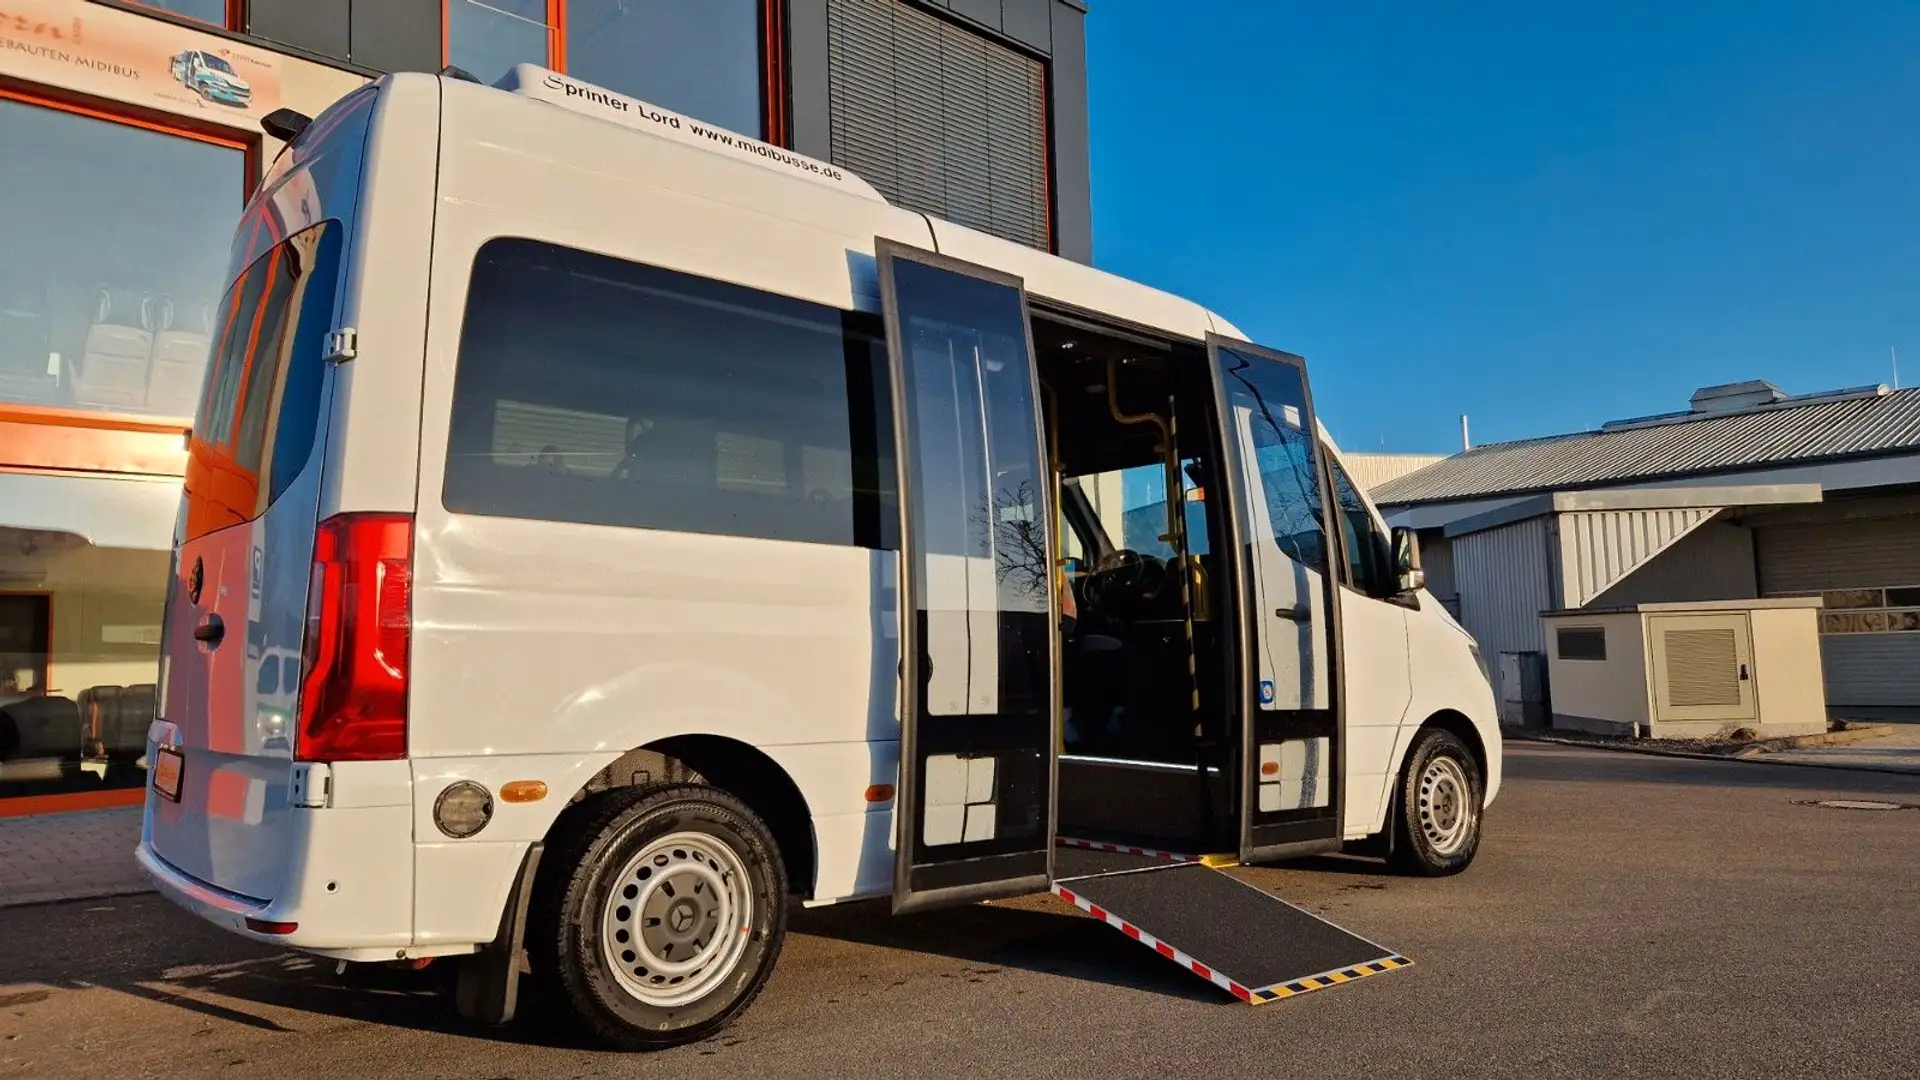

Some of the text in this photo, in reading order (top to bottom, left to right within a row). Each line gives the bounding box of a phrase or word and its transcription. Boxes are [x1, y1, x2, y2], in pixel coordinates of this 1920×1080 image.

[75, 57, 140, 79] MIDIBUS
[543, 74, 842, 181] Sprinter Lord www.midibusse.de
